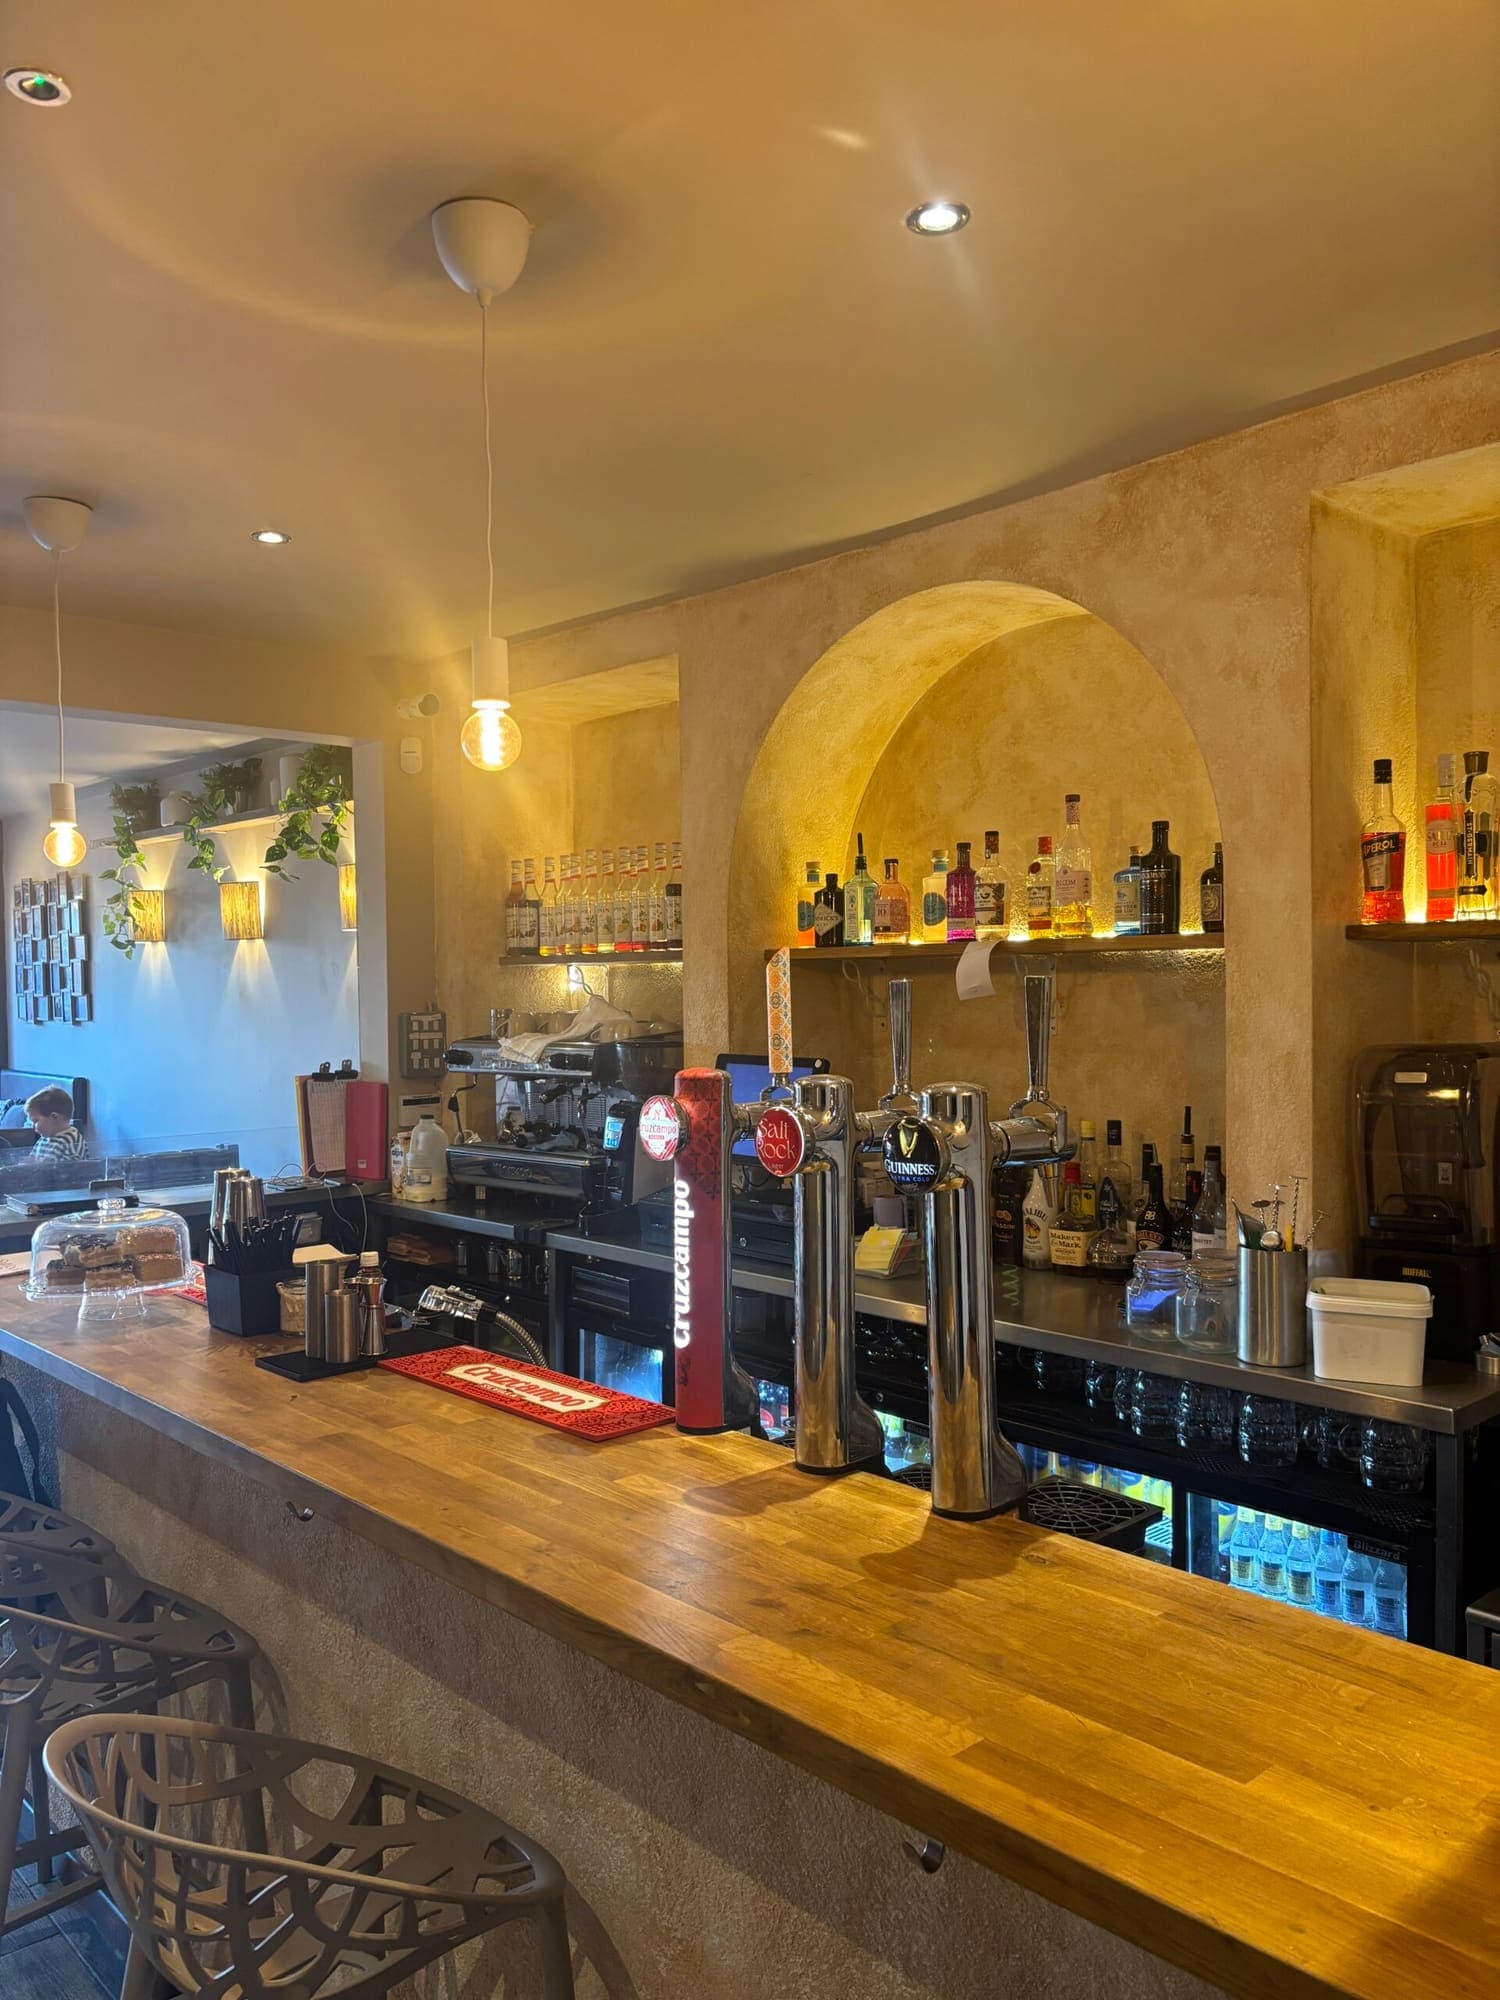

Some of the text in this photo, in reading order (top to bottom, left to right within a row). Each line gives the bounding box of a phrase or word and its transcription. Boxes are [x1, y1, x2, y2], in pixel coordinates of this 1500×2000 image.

[759, 1118, 788, 1139] Salt
[756, 1140, 796, 1160] Rock
[884, 1159, 936, 1176] GUINNESS
[674, 1179, 695, 1349] cruzcampo
[463, 1365, 587, 1408] Cruzcampo
[1353, 1538, 1401, 1561] Blizzard
